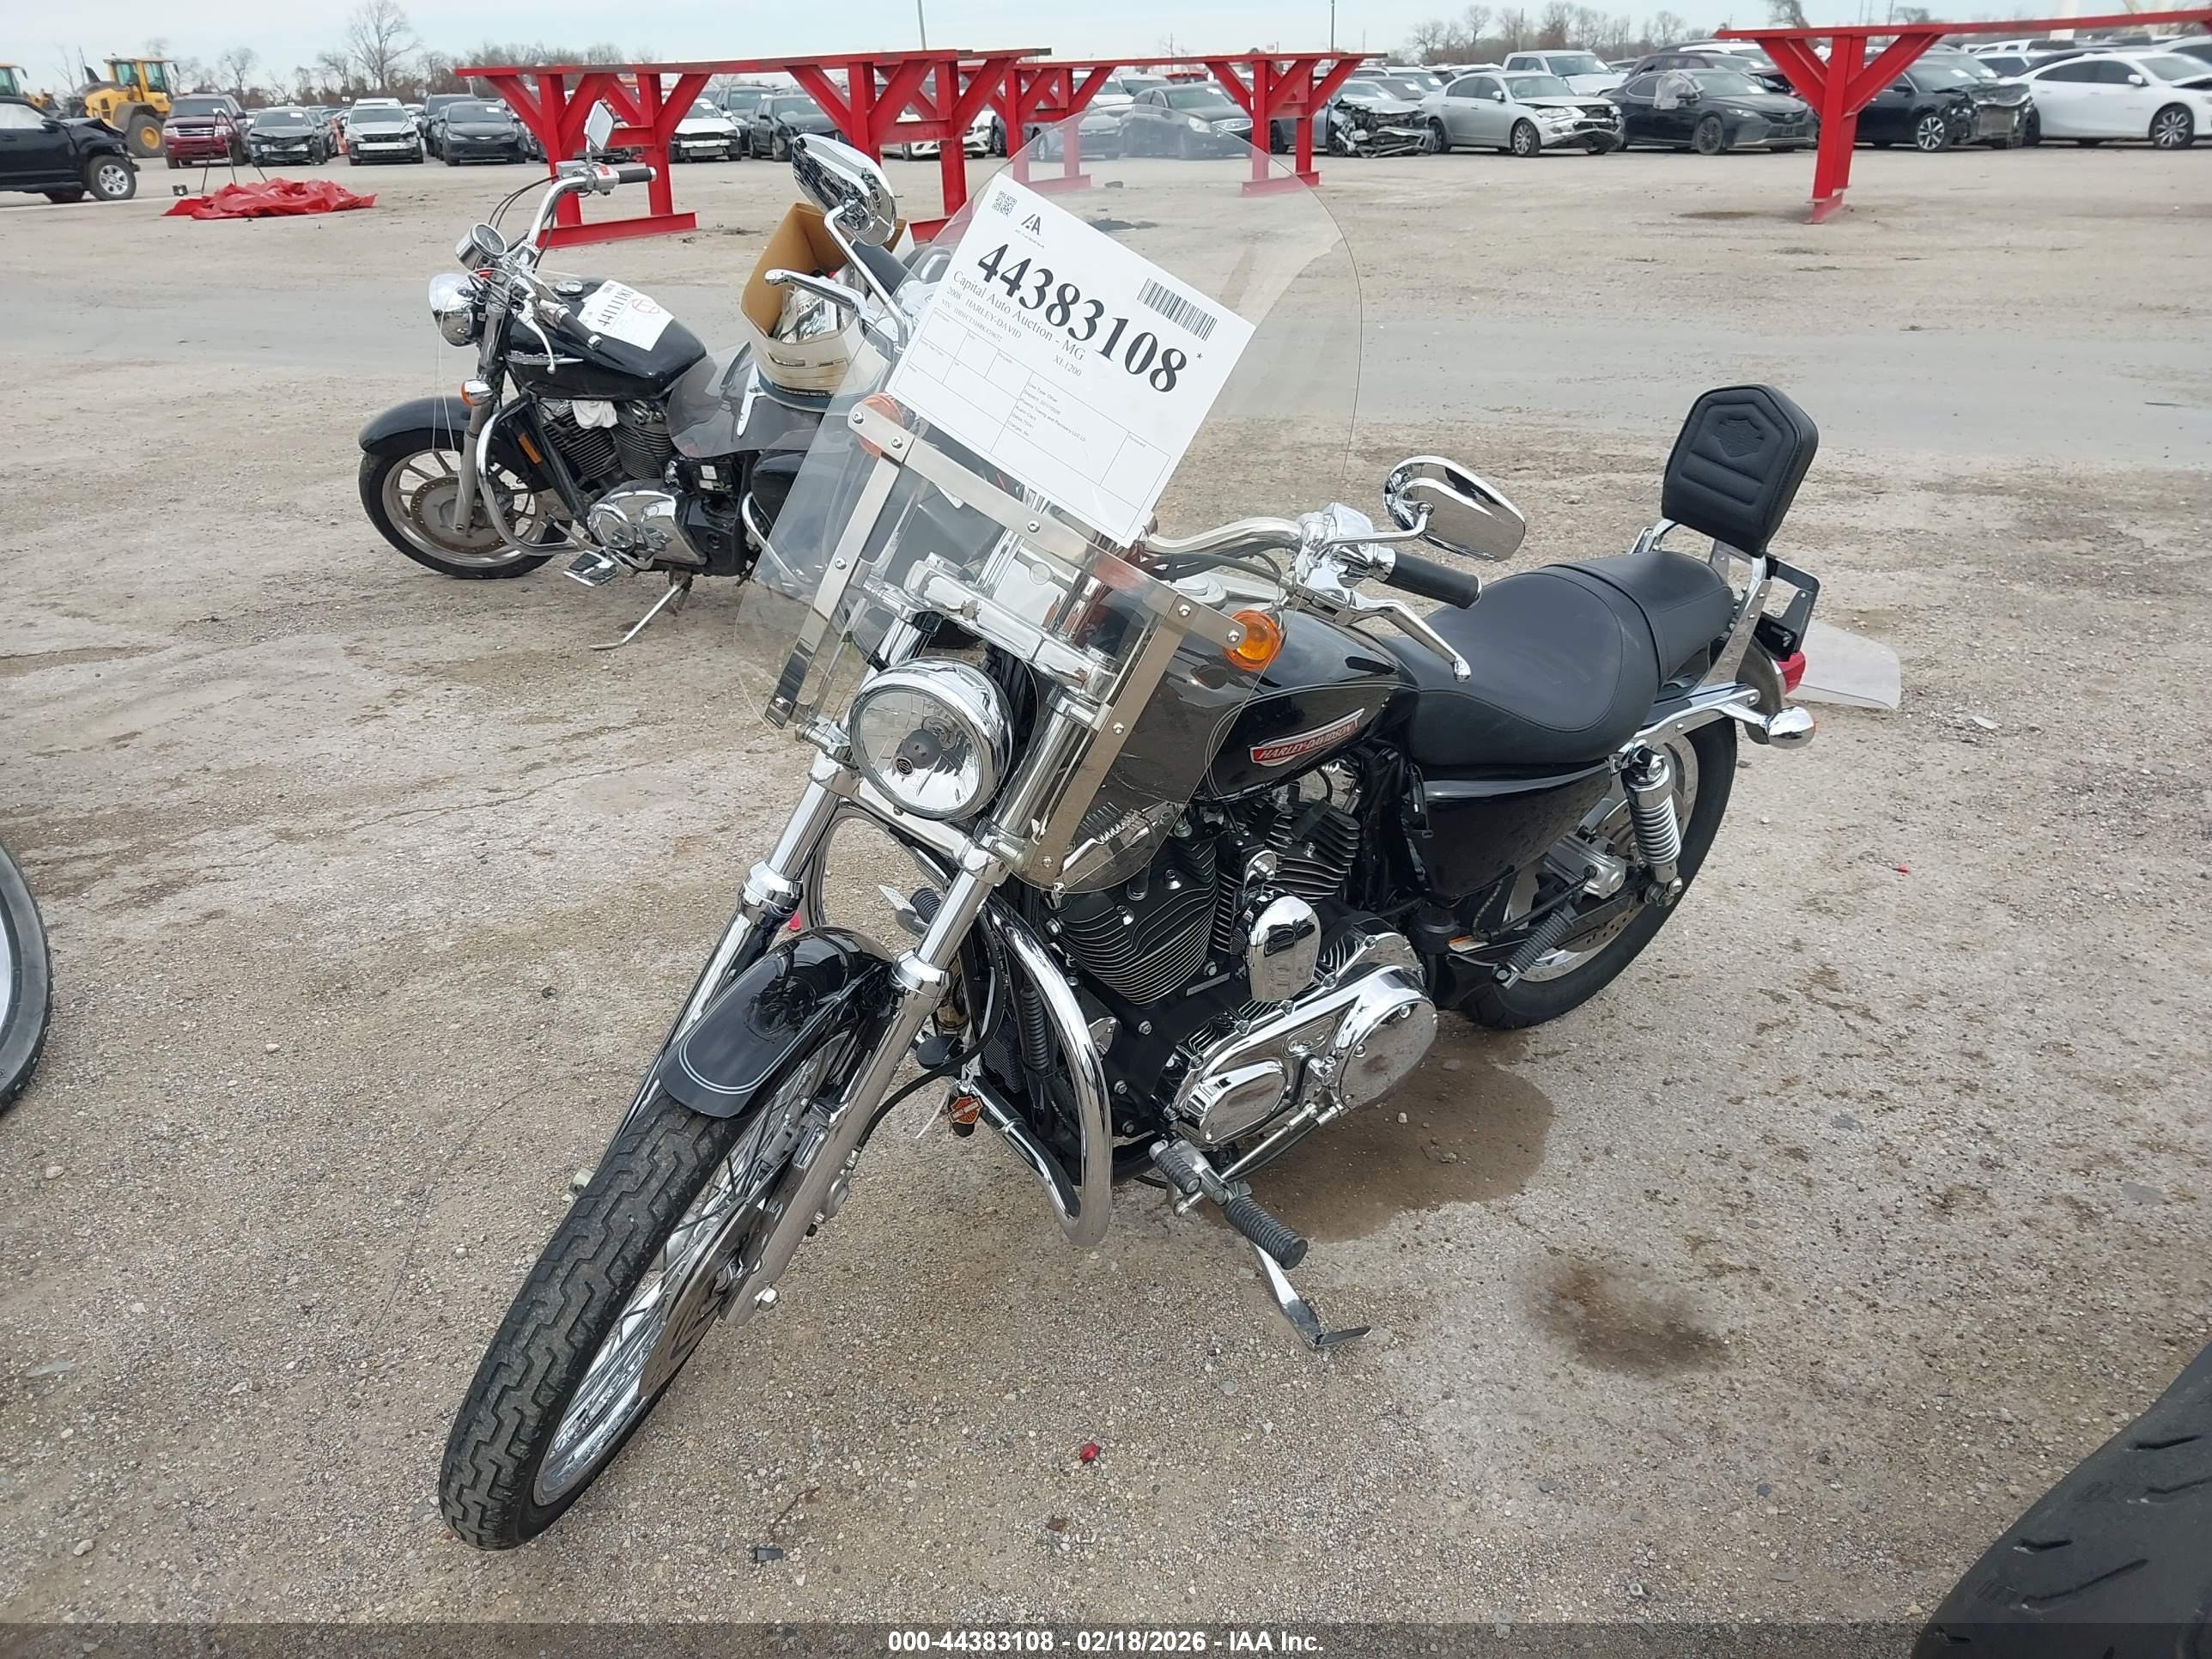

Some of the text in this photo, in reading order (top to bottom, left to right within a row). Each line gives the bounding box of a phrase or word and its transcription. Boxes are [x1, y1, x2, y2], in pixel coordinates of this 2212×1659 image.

[946, 286, 963, 301] 2008
[965, 298, 1022, 339] HARLEY-DAVID
[1053, 354, 1082, 377] XL1200
[953, 270, 988, 299] Capital
[986, 293, 1012, 315] Auto
[1012, 308, 1054, 342] Auction
[1061, 338, 1086, 361] MG
[977, 243, 1188, 393] 44383108
[1259, 725, 1352, 760] HARLEY-DAVIDSON
